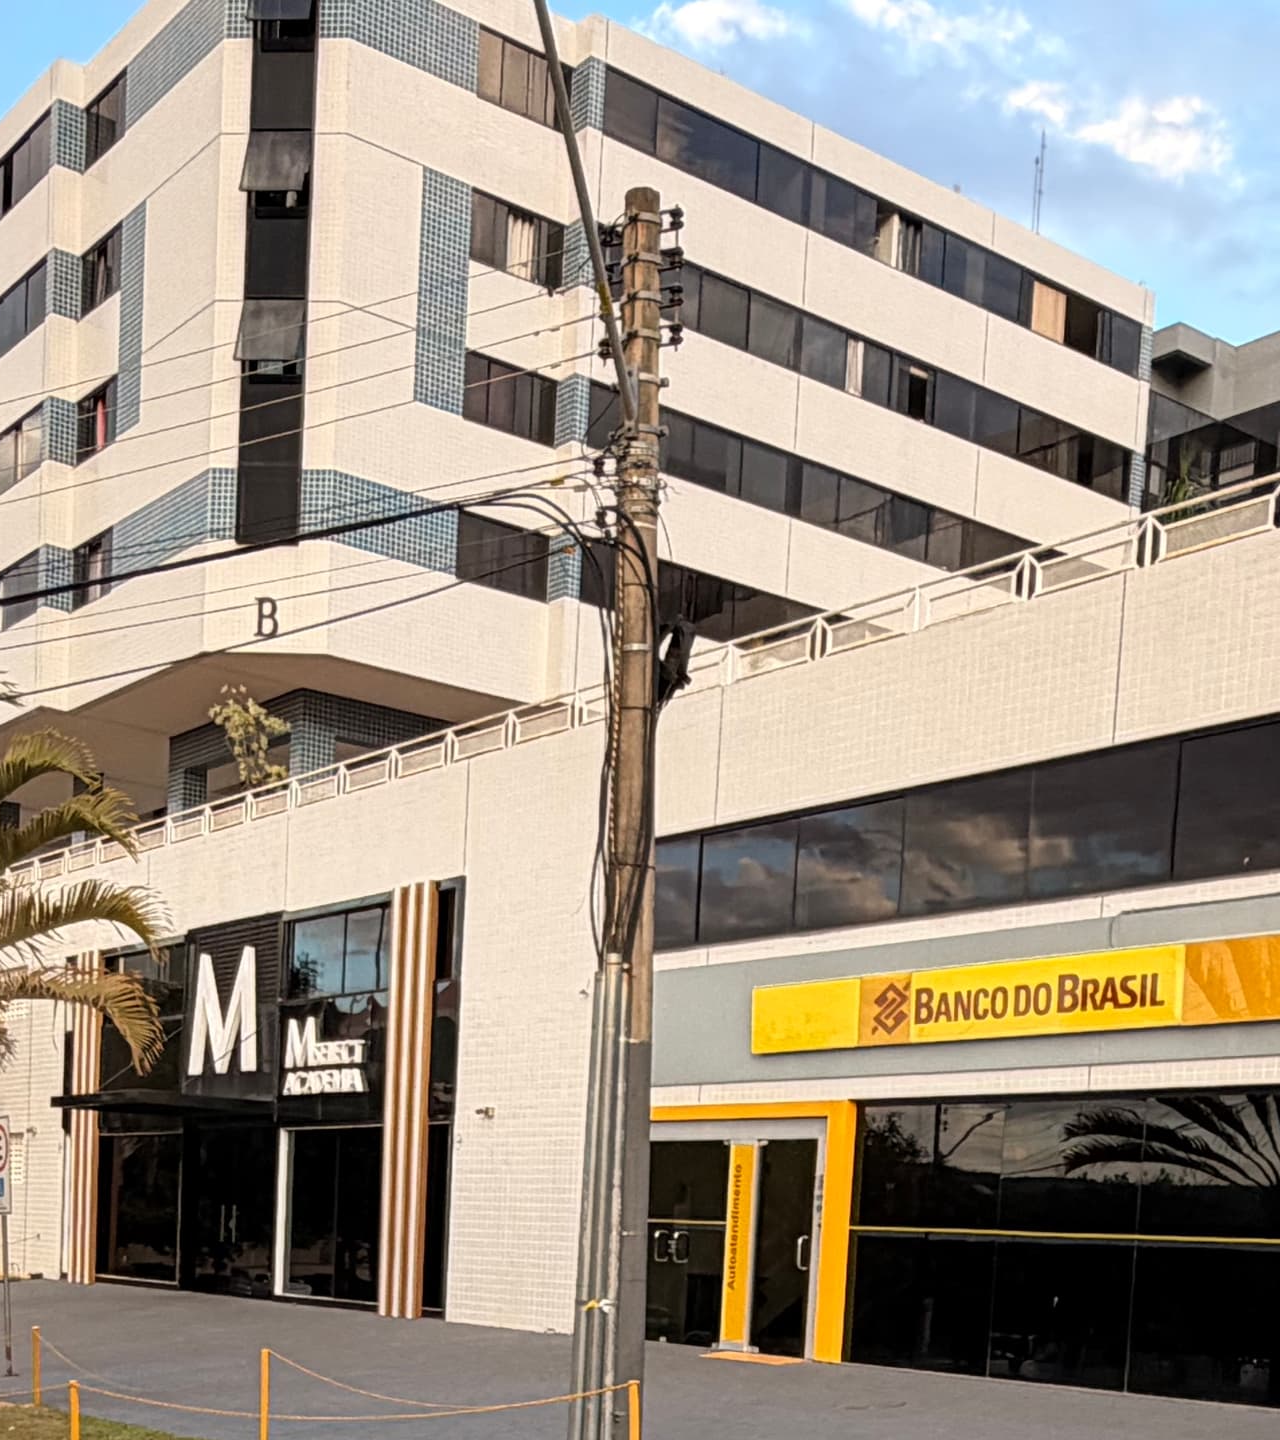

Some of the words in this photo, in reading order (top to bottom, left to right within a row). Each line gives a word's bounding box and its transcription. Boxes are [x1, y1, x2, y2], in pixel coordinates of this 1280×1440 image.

[254, 597, 278, 637] B
[188, 946, 257, 1076] M
[914, 986, 1008, 1025] BANCO
[1014, 983, 1052, 1017] DO
[1057, 973, 1165, 1014] BRASIL
